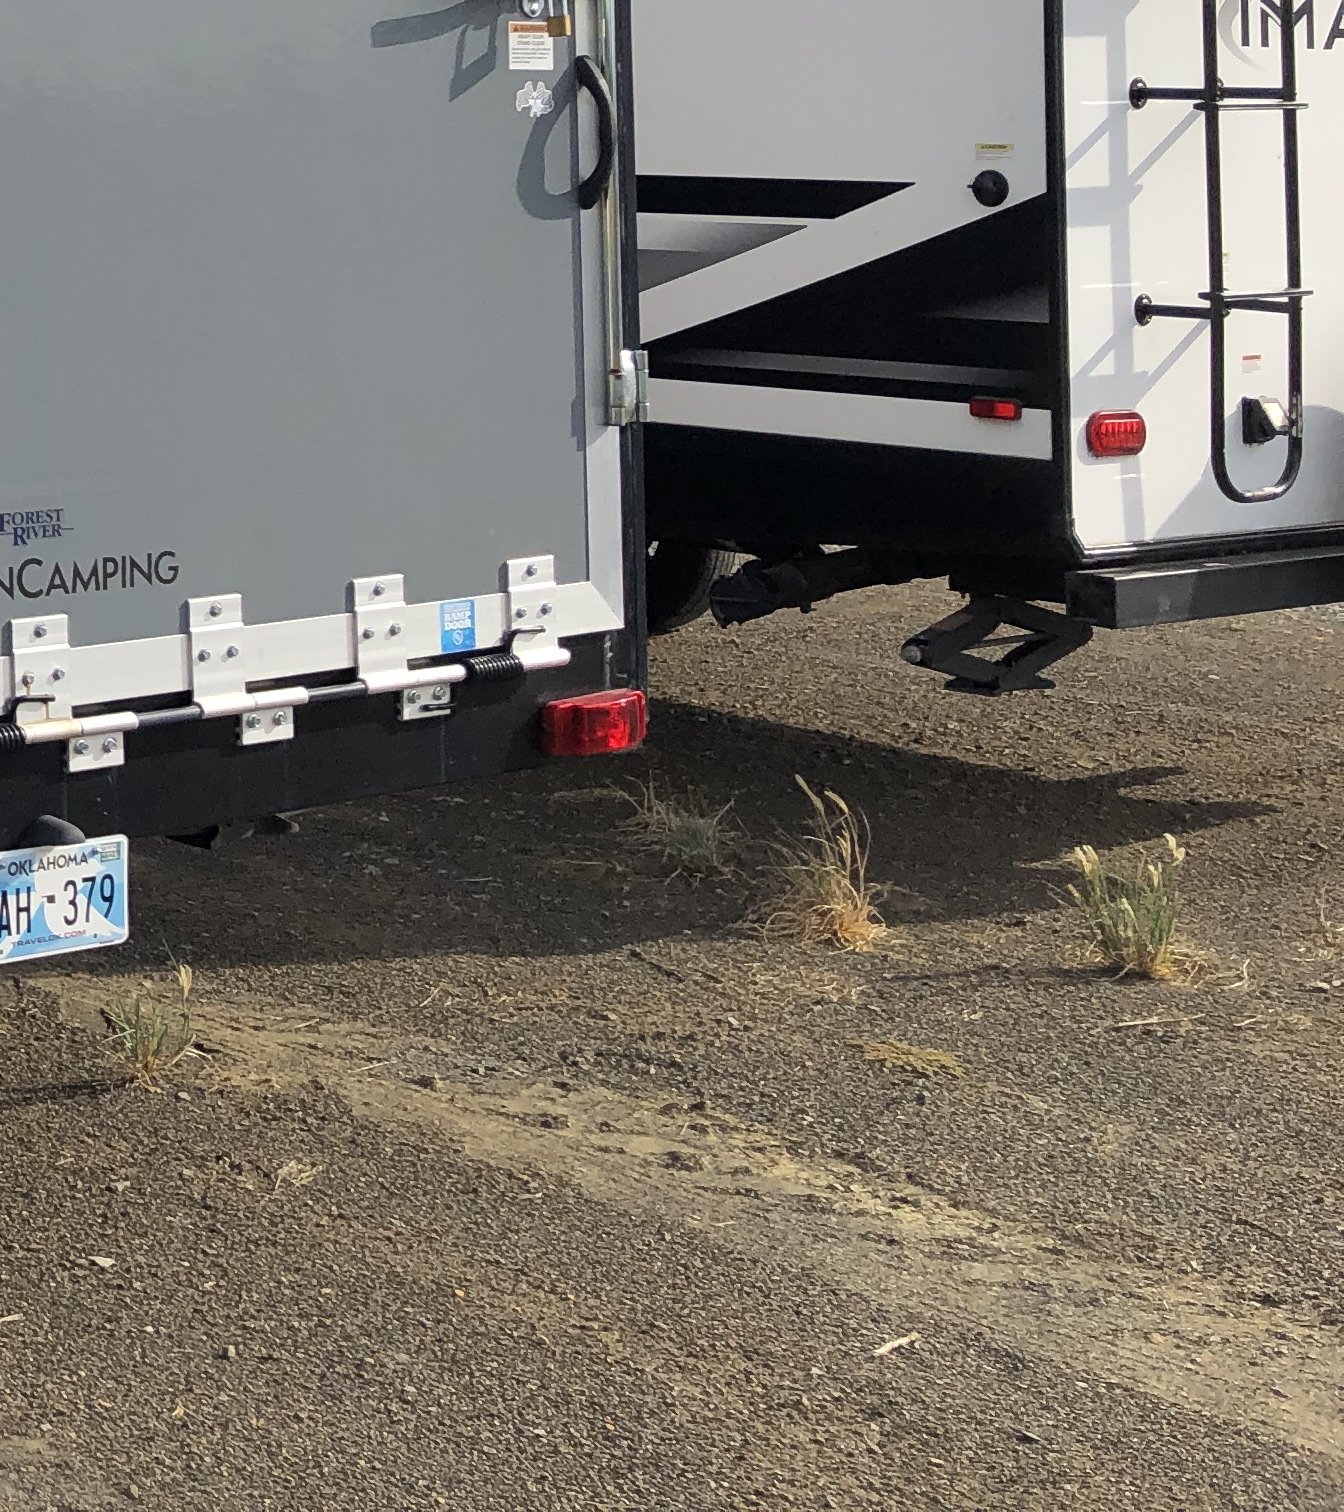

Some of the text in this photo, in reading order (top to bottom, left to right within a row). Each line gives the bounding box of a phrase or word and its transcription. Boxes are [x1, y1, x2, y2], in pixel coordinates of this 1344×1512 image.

[11, 523, 63, 547] RIVER
[7, 851, 89, 877] OKLAHOMA
[11, 929, 87, 947] TRAVELOK.COM
